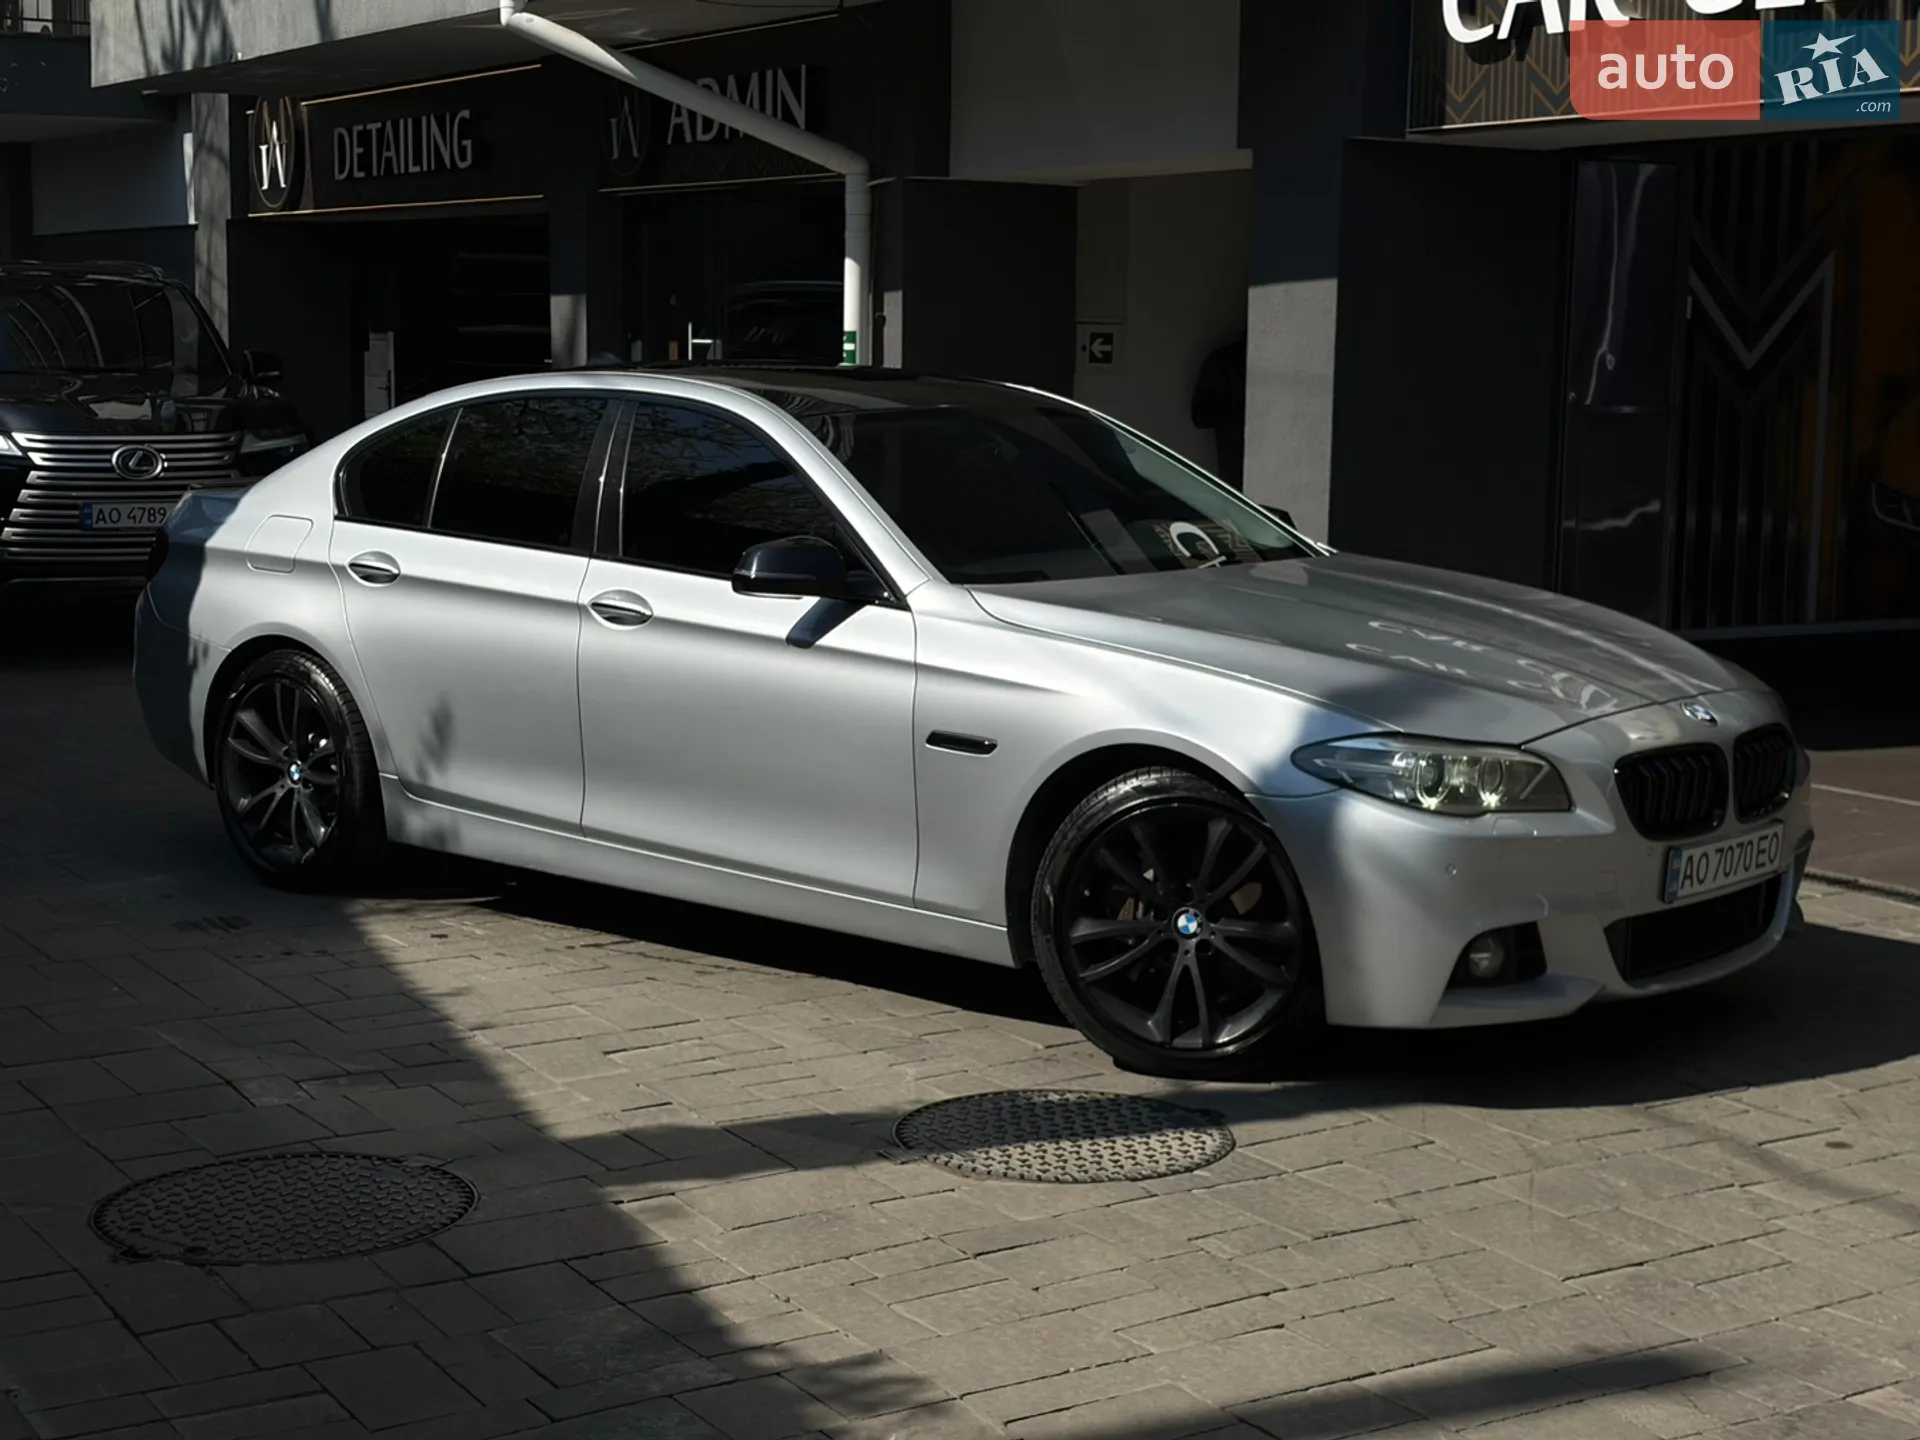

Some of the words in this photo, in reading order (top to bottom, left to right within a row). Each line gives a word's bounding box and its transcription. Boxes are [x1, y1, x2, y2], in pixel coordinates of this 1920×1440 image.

[666, 63, 807, 146] ADMIN
[333, 108, 473, 181] DETAILING
[95, 507, 121, 525] AO
[127, 506, 167, 524] 4789
